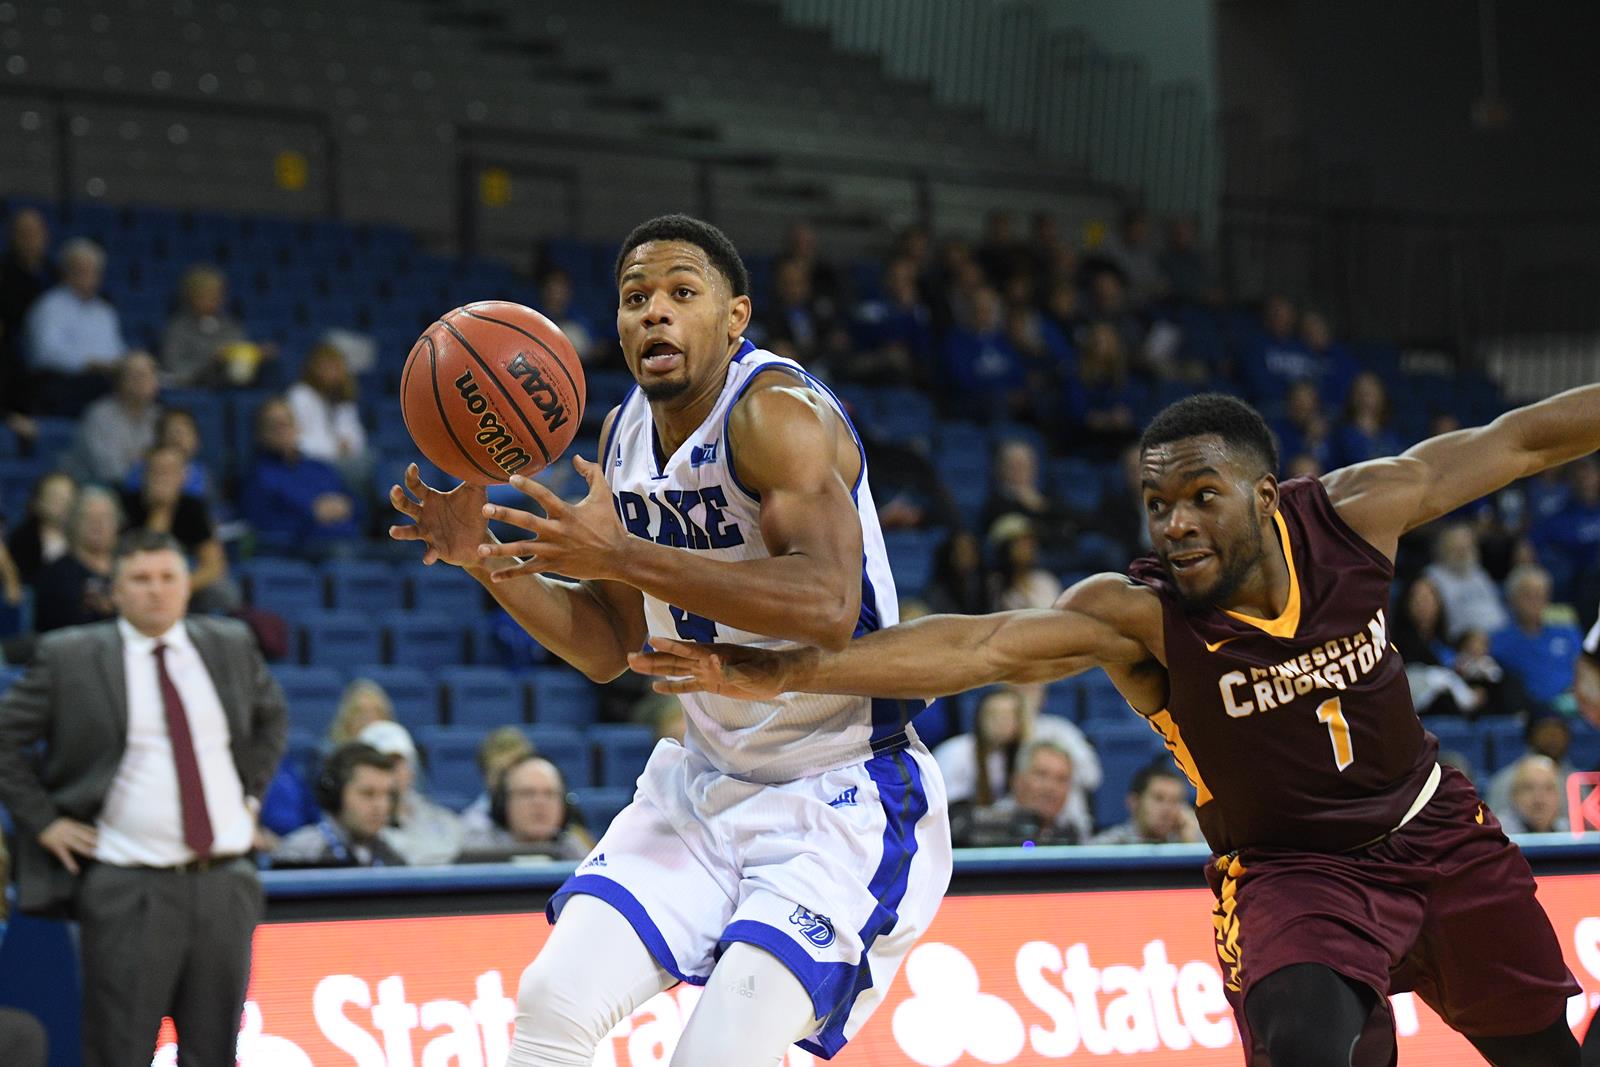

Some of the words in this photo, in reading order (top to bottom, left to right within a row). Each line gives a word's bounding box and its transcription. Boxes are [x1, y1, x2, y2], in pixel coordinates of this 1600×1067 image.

[455, 369, 533, 476] Wilson
[506, 352, 569, 433] NCAA
[613, 485, 745, 550] RAKE
[1219, 608, 1387, 718] CROOKSTON
[1316, 696, 1355, 773] 1
[312, 969, 516, 1067] Stat
[1015, 939, 1234, 1059] State
